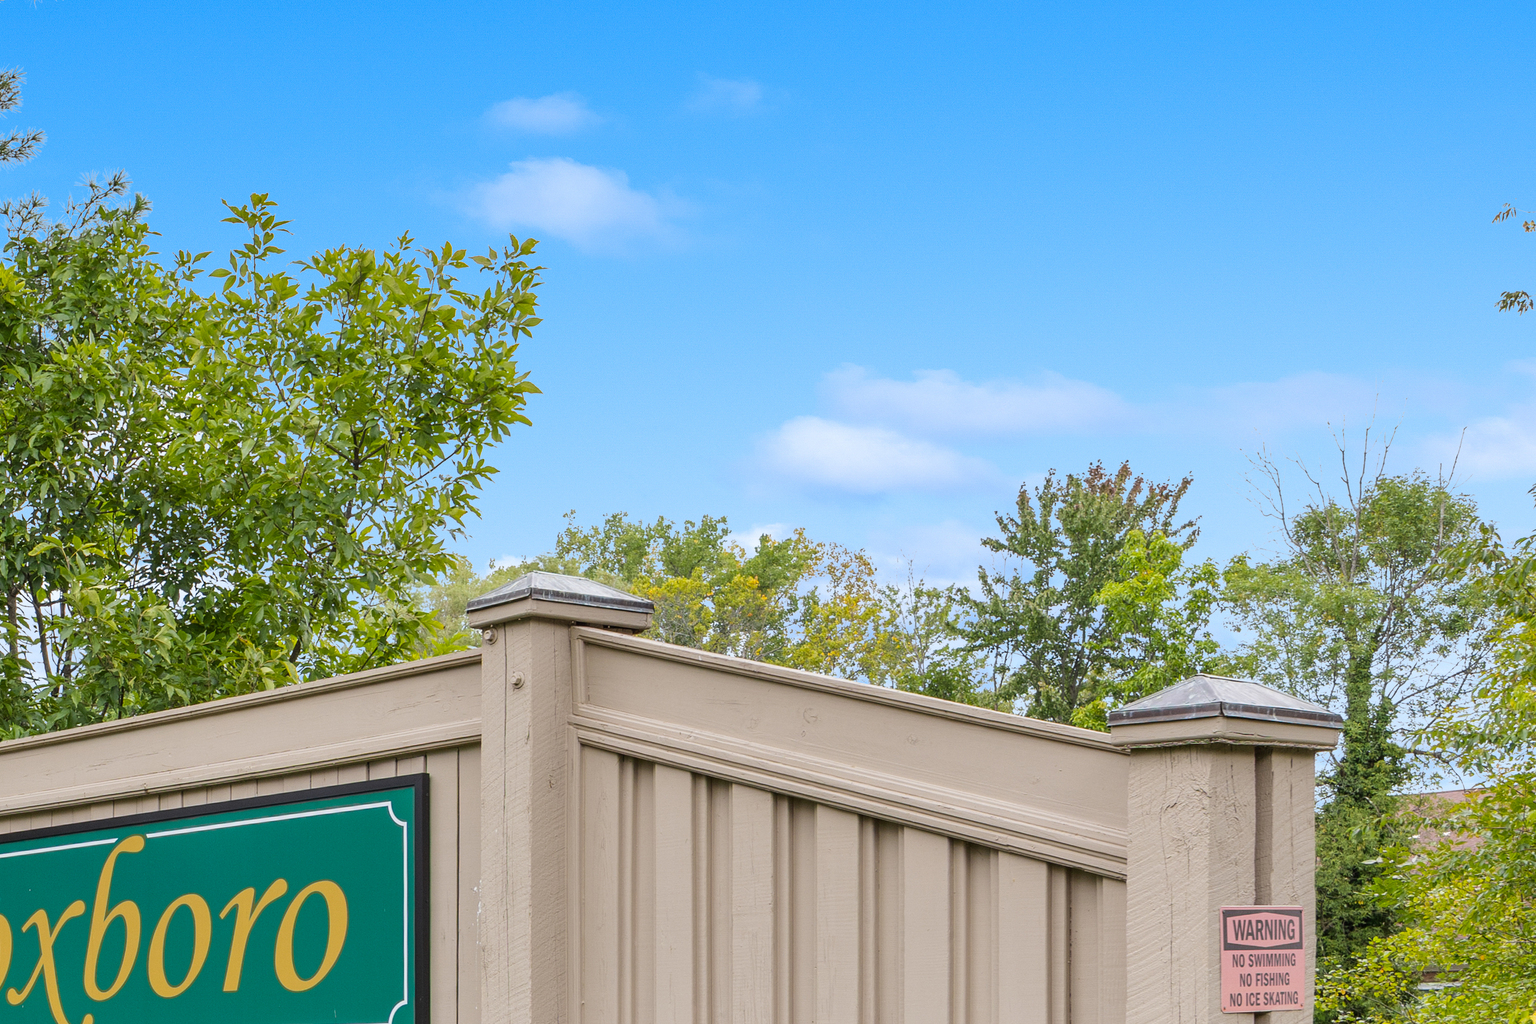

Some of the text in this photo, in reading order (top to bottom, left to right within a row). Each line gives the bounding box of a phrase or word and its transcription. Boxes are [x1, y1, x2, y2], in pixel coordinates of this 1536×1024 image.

[1232, 919, 1296, 941] WARNING
[1232, 953, 1296, 968] NO SWIMMING
[1239, 972, 1290, 987] NO FISHING
[1229, 991, 1299, 1007] NO ICE SKATING
